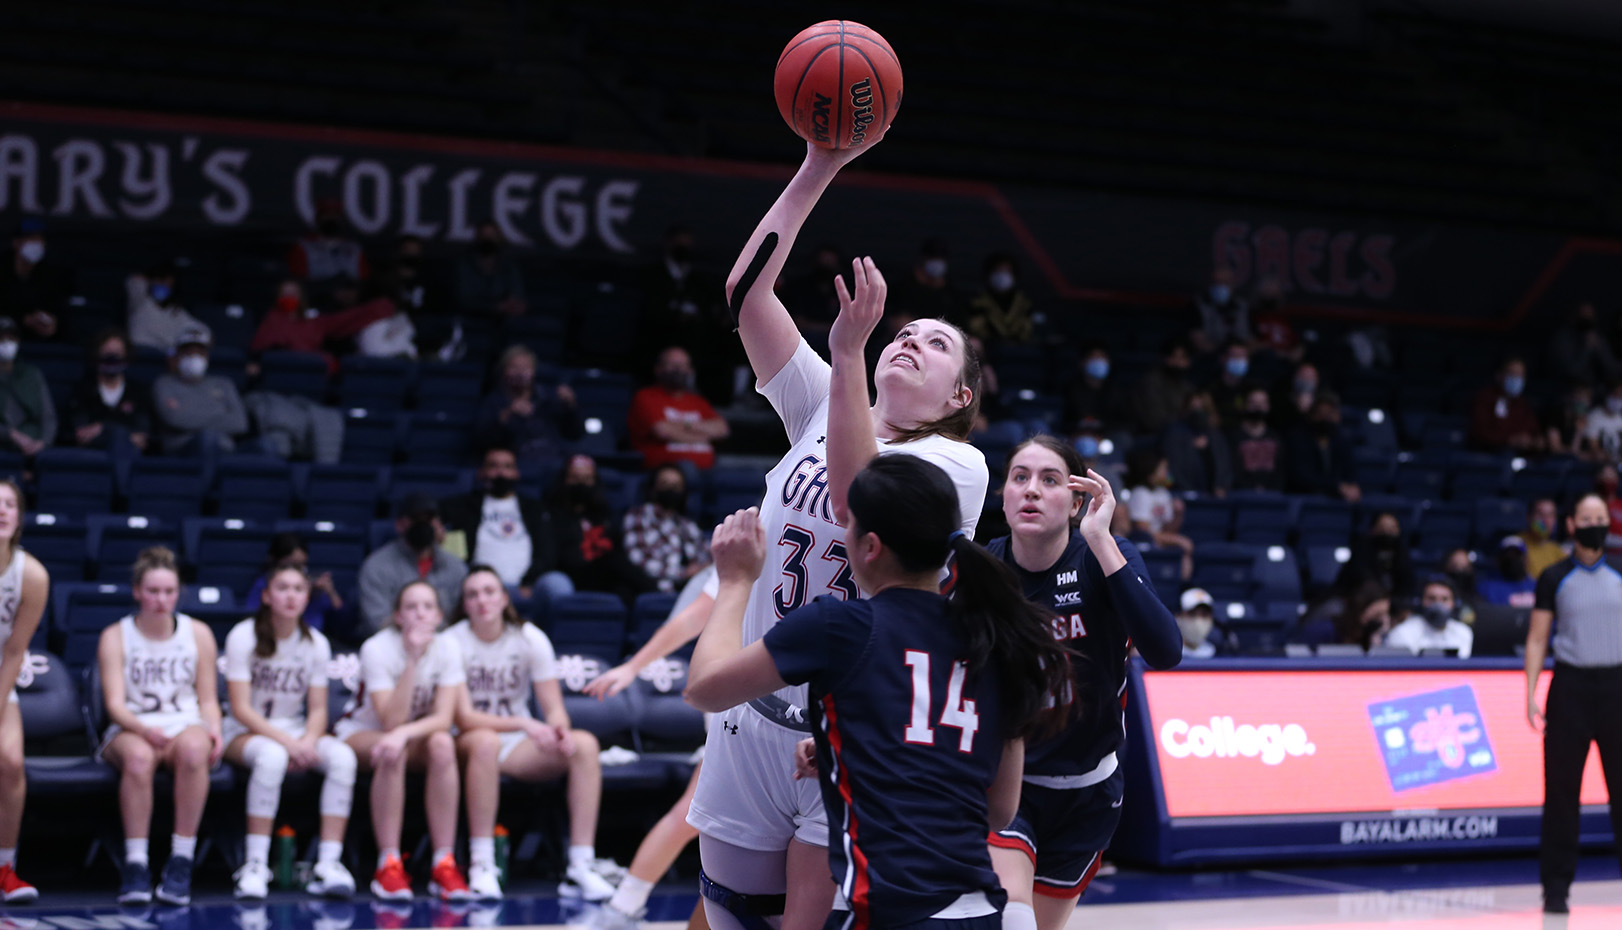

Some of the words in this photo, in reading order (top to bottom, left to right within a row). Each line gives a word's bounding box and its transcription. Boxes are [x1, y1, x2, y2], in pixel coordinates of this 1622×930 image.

[812, 92, 832, 144] NCAA
[295, 155, 641, 252] COLLEGE
[1211, 219, 1397, 299] GAELS
[1056, 570, 1078, 586] HM
[130, 656, 194, 687] GAELS
[904, 648, 979, 754] 14
[1160, 716, 1316, 765] College.
[1340, 815, 1498, 845] BAYALARM.COM
